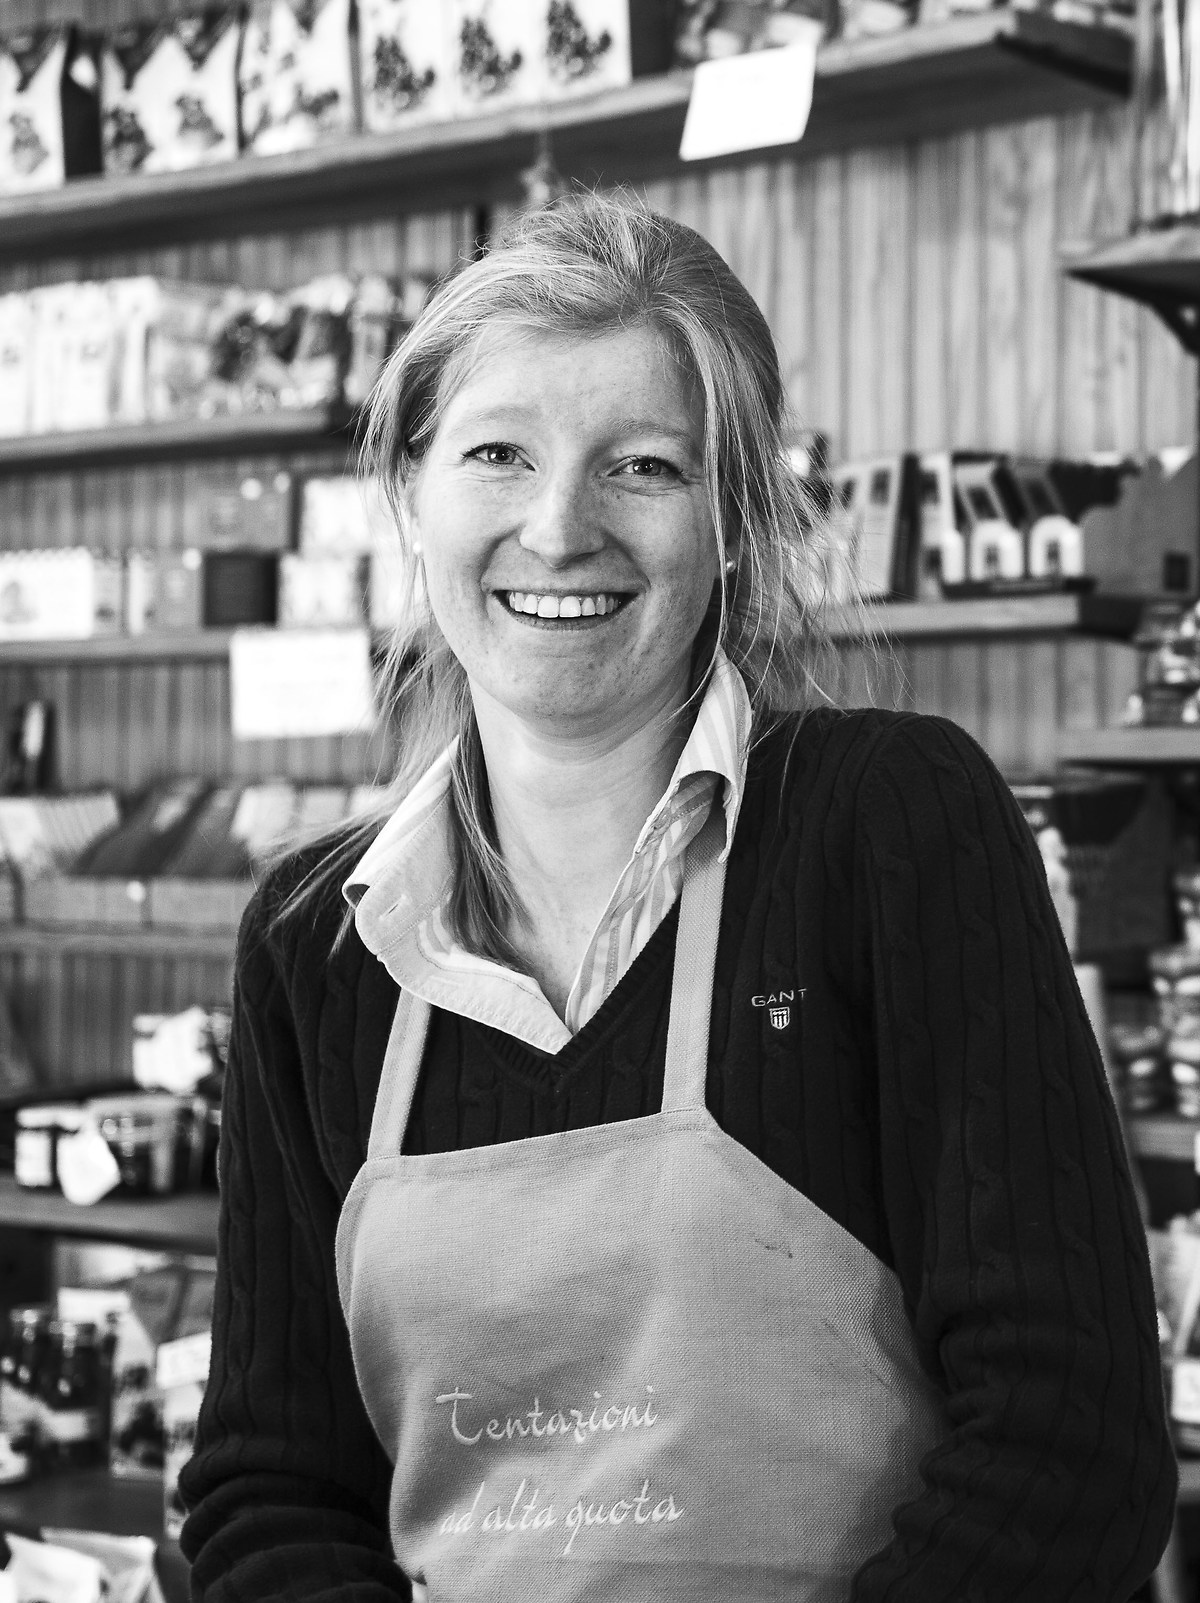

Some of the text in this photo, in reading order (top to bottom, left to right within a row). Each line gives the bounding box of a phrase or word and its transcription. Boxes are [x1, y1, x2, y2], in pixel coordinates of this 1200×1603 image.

[751, 988, 808, 1008] GANT
[435, 1385, 659, 1446] Tentazioni
[439, 1478, 685, 1556] ad alta quota
